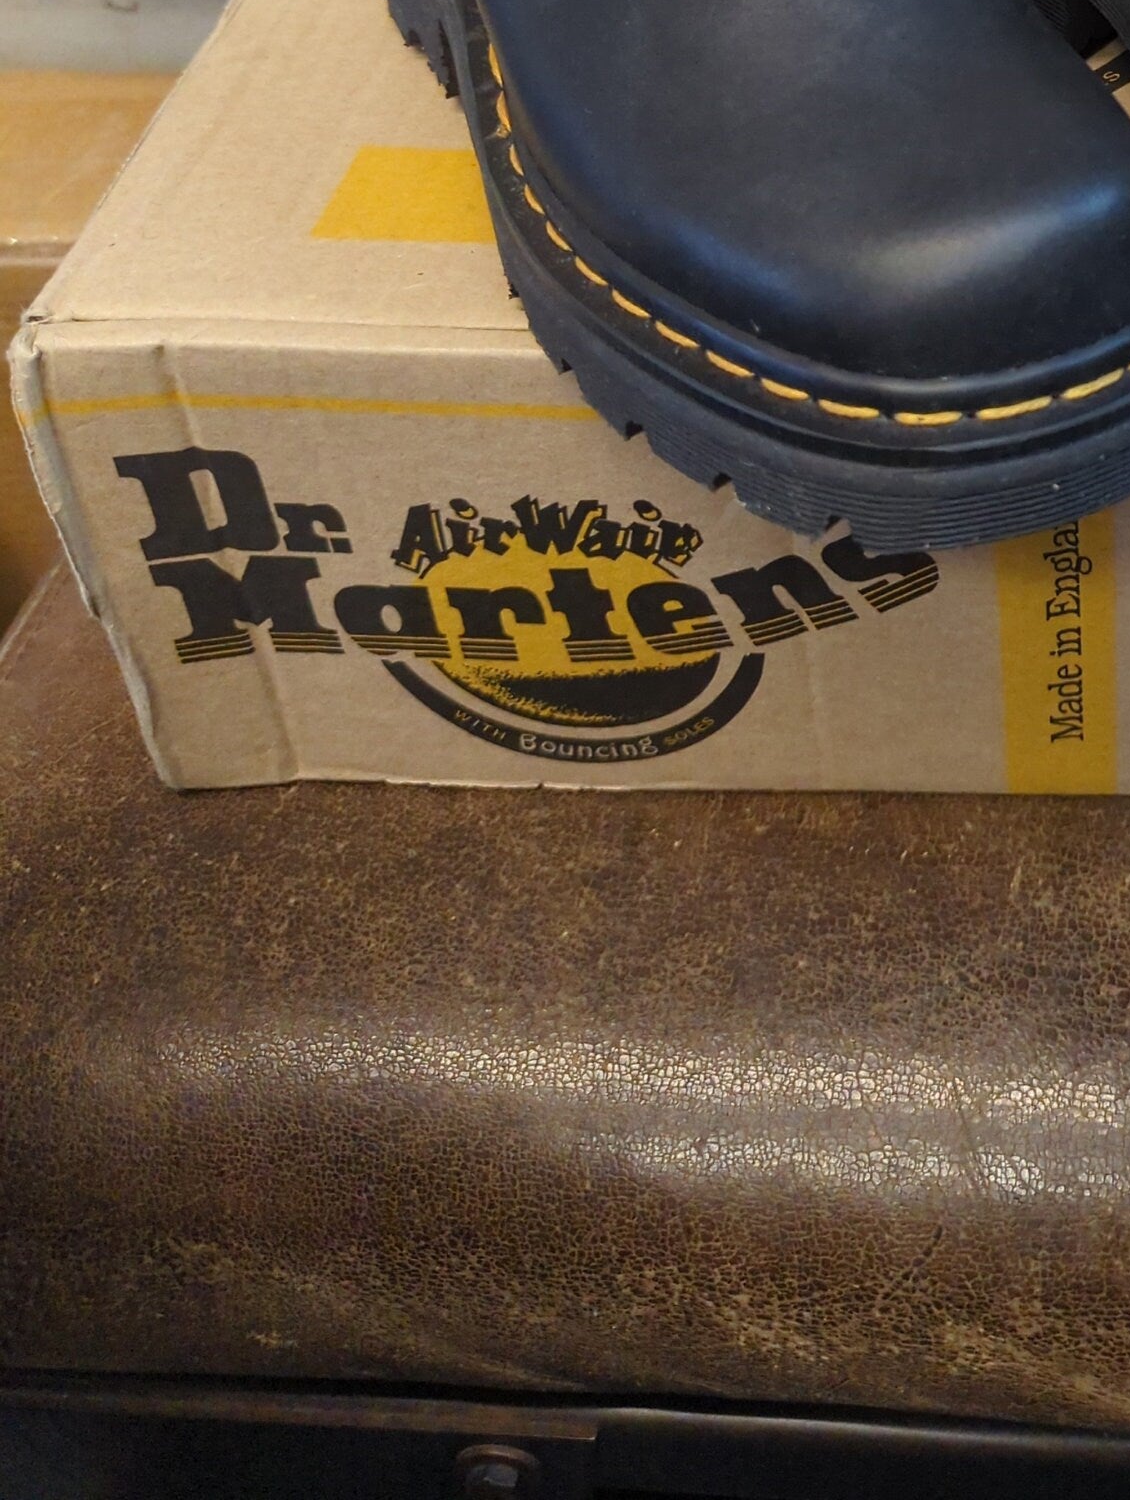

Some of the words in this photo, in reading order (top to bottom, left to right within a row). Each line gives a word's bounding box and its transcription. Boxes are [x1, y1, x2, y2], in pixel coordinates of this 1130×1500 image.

[114, 446, 354, 560] Dr.
[392, 493, 704, 580] AirWair
[148, 534, 941, 665] Martens
[1049, 625, 1083, 657] in
[453, 707, 508, 742] WITH
[519, 731, 660, 759] Bouncing
[661, 715, 717, 747] SOLES
[1049, 662, 1084, 743] Made
